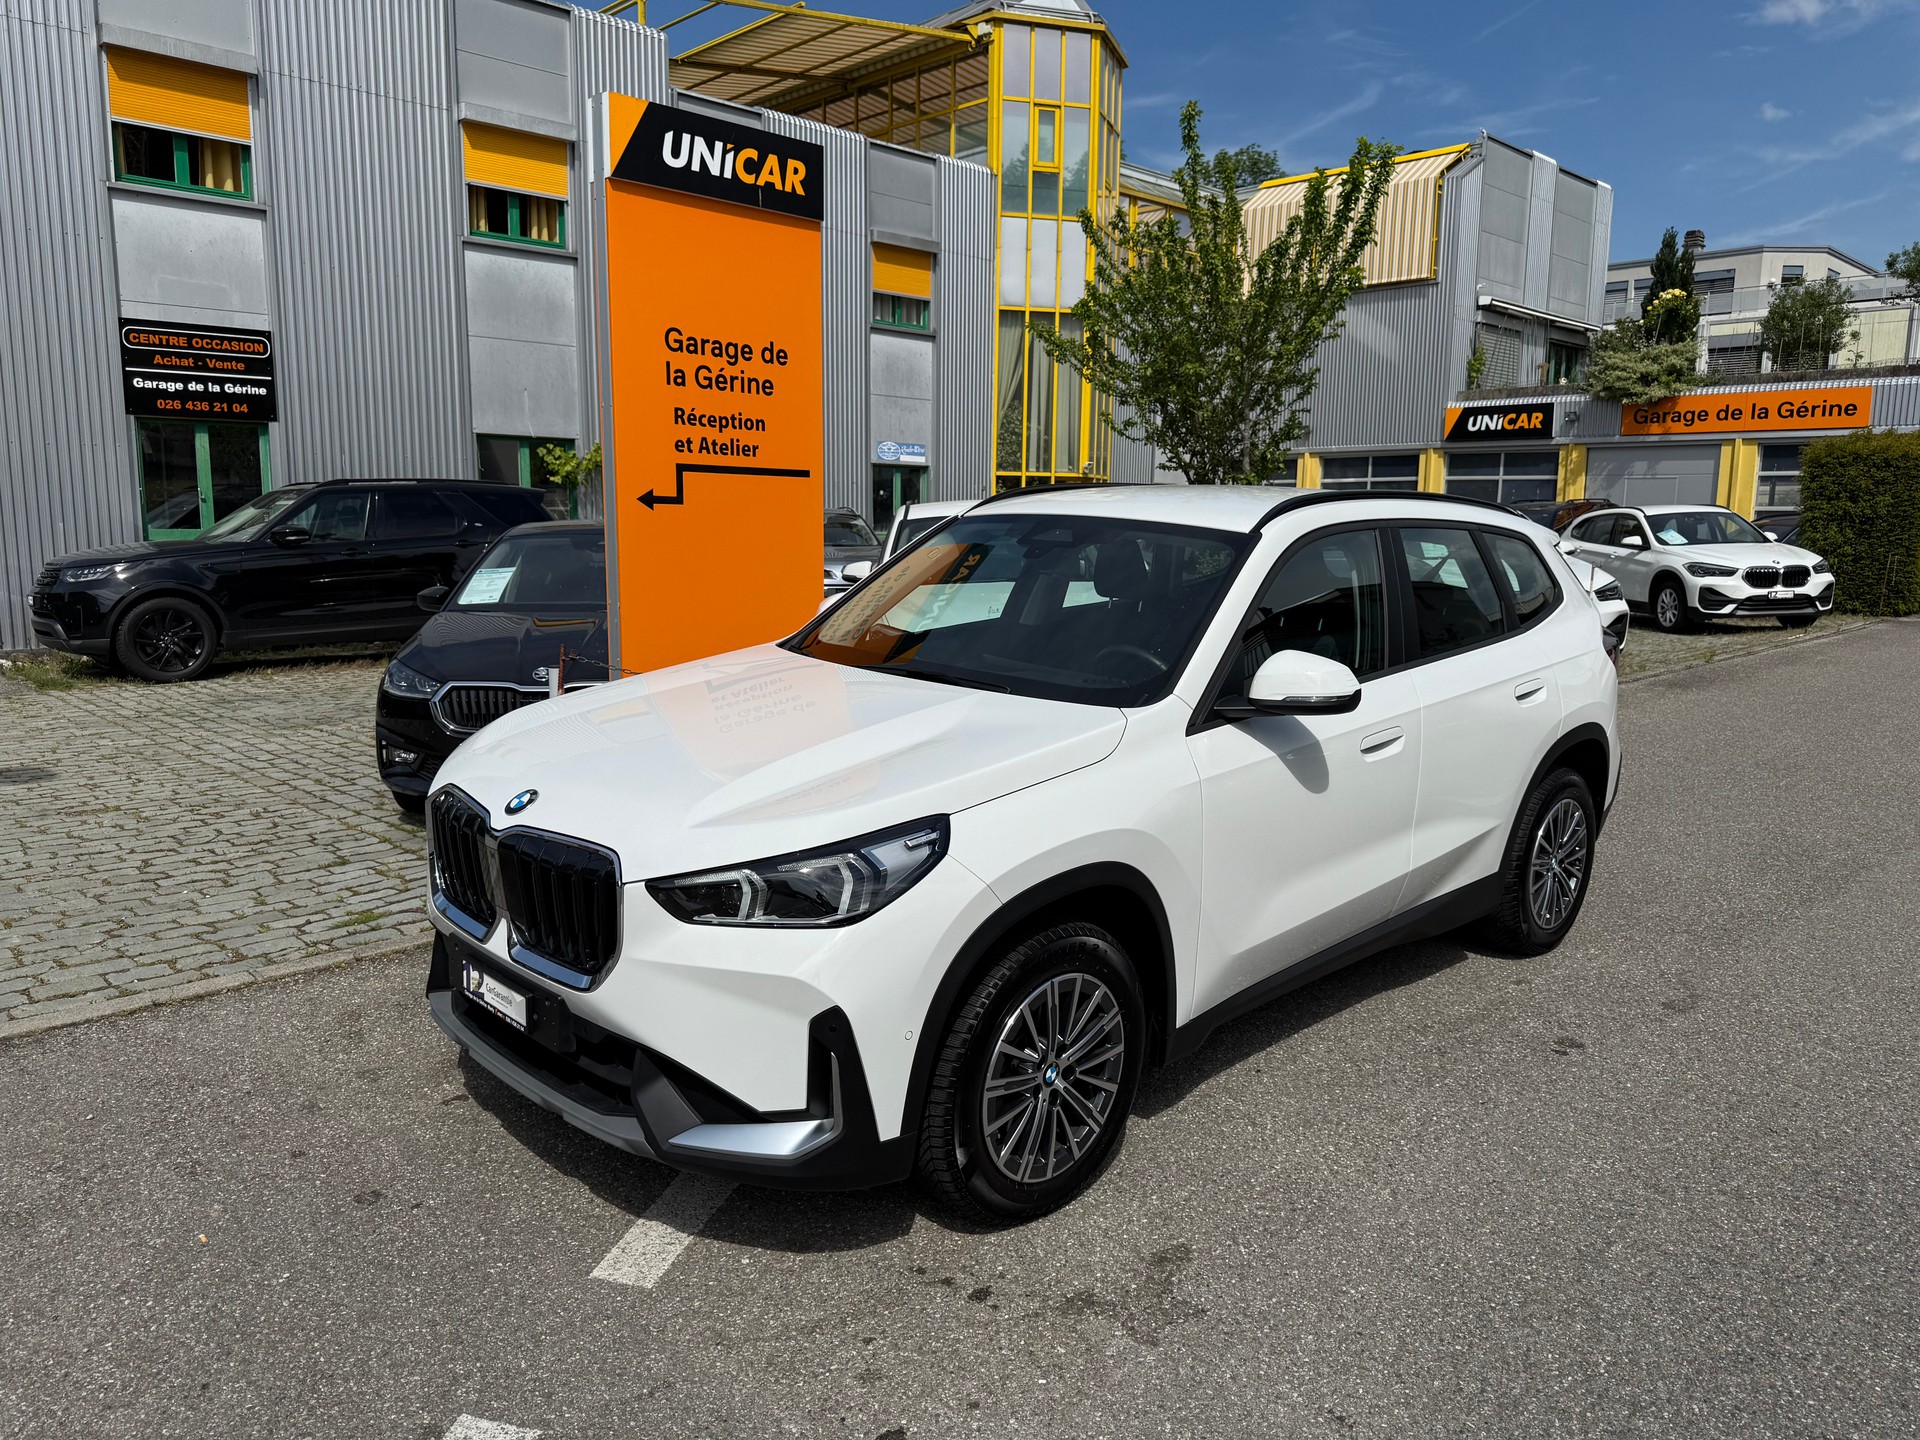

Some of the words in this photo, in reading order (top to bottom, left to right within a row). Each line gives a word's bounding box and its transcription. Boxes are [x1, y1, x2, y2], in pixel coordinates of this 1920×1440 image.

[129, 333, 188, 347] CENTRE
[192, 337, 264, 353] OCCASION
[664, 327, 753, 366] Garage
[761, 341, 788, 366] de
[153, 355, 195, 367] Achat
[206, 358, 245, 371] Vente
[132, 378, 184, 392] Garage
[187, 381, 204, 392] de
[208, 382, 221, 393] la
[224, 383, 267, 395] Gérine
[665, 361, 686, 387] la
[694, 365, 774, 396] Gérine
[156, 399, 182, 410] 026
[185, 400, 209, 411] 436
[213, 402, 228, 412] 21
[232, 403, 248, 413] 04
[1633, 407, 1709, 427] Garage
[1716, 404, 1743, 421] de
[1751, 403, 1769, 420] la
[1777, 399, 1858, 419] Gérine
[673, 407, 766, 433] Réception
[674, 437, 693, 453] et
[698, 436, 759, 458] Atelier
